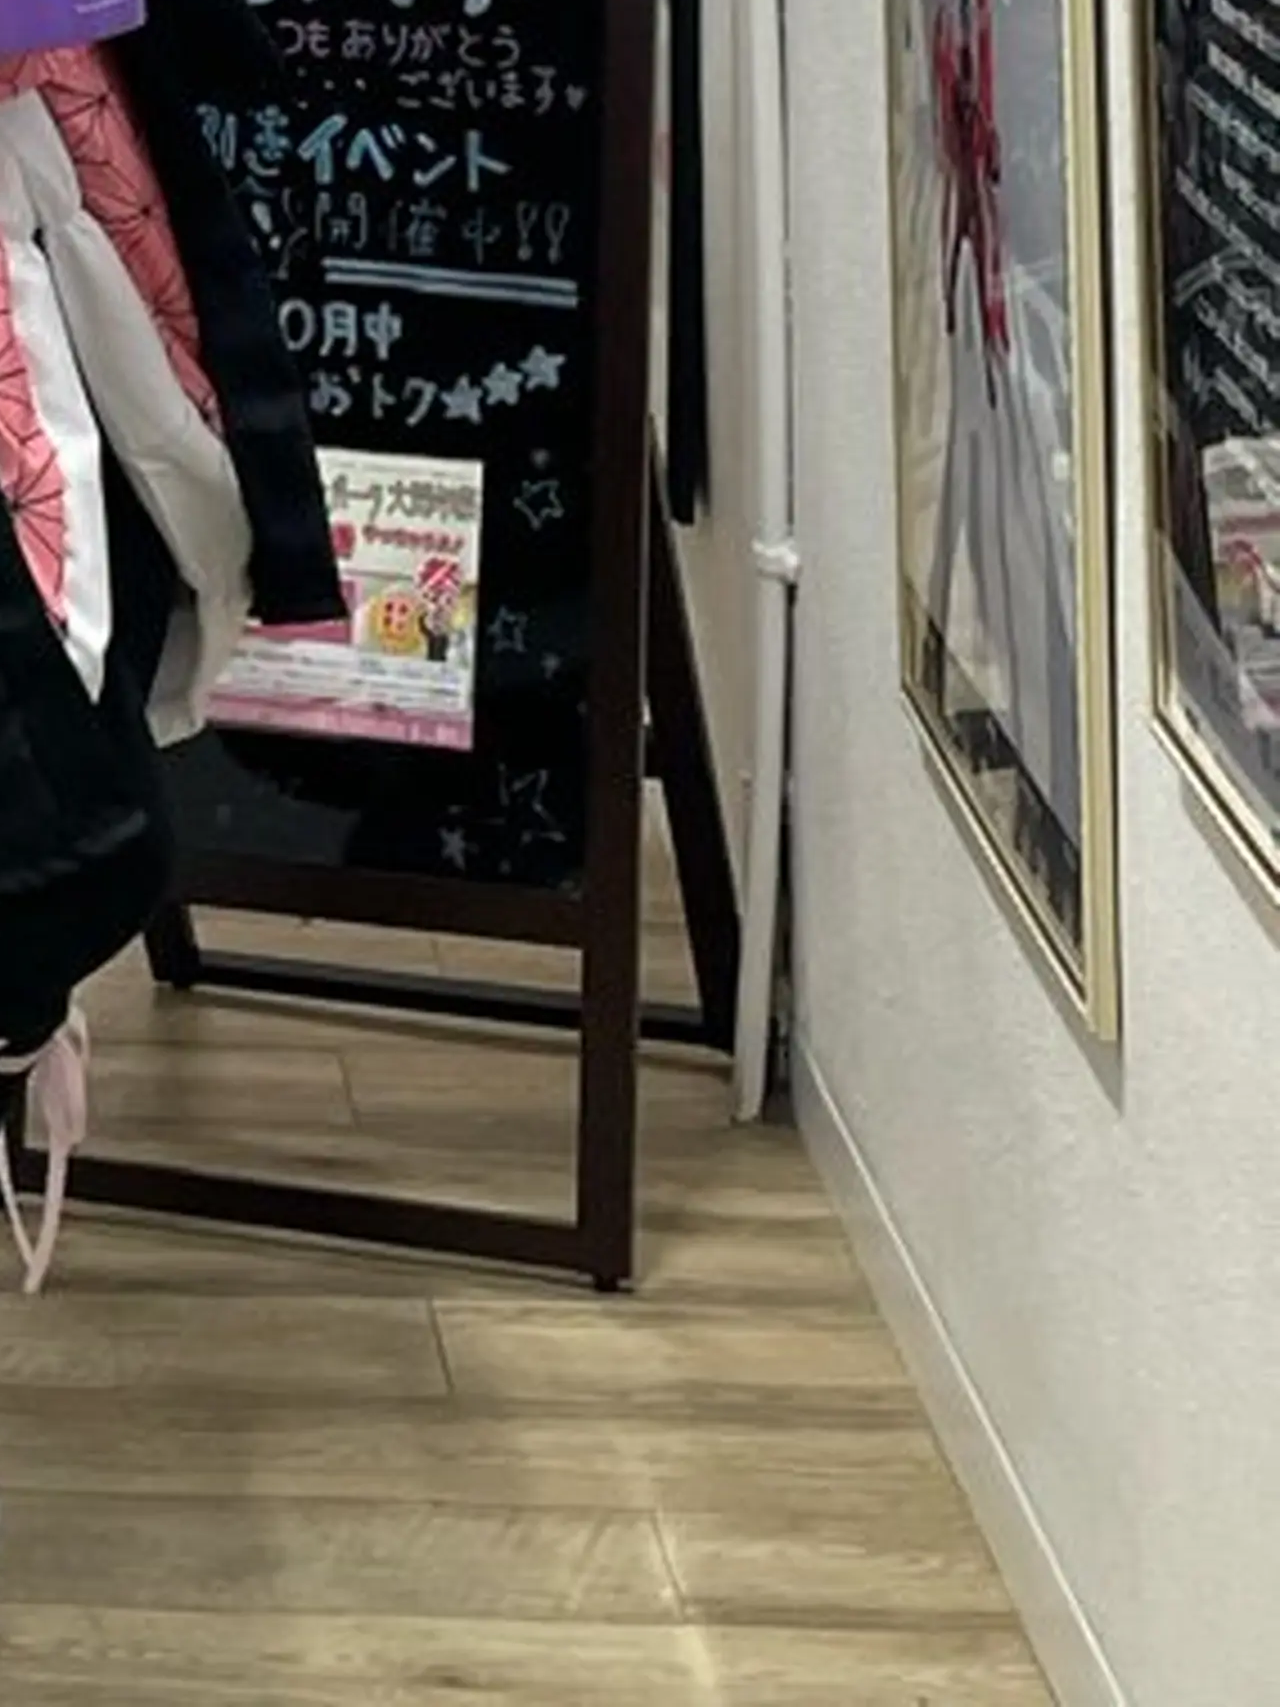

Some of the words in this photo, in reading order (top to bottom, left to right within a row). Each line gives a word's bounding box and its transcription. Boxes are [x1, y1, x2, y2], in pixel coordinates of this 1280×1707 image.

[276, 17, 521, 69] つもありがとう
[278, 296, 403, 362] 0月中
